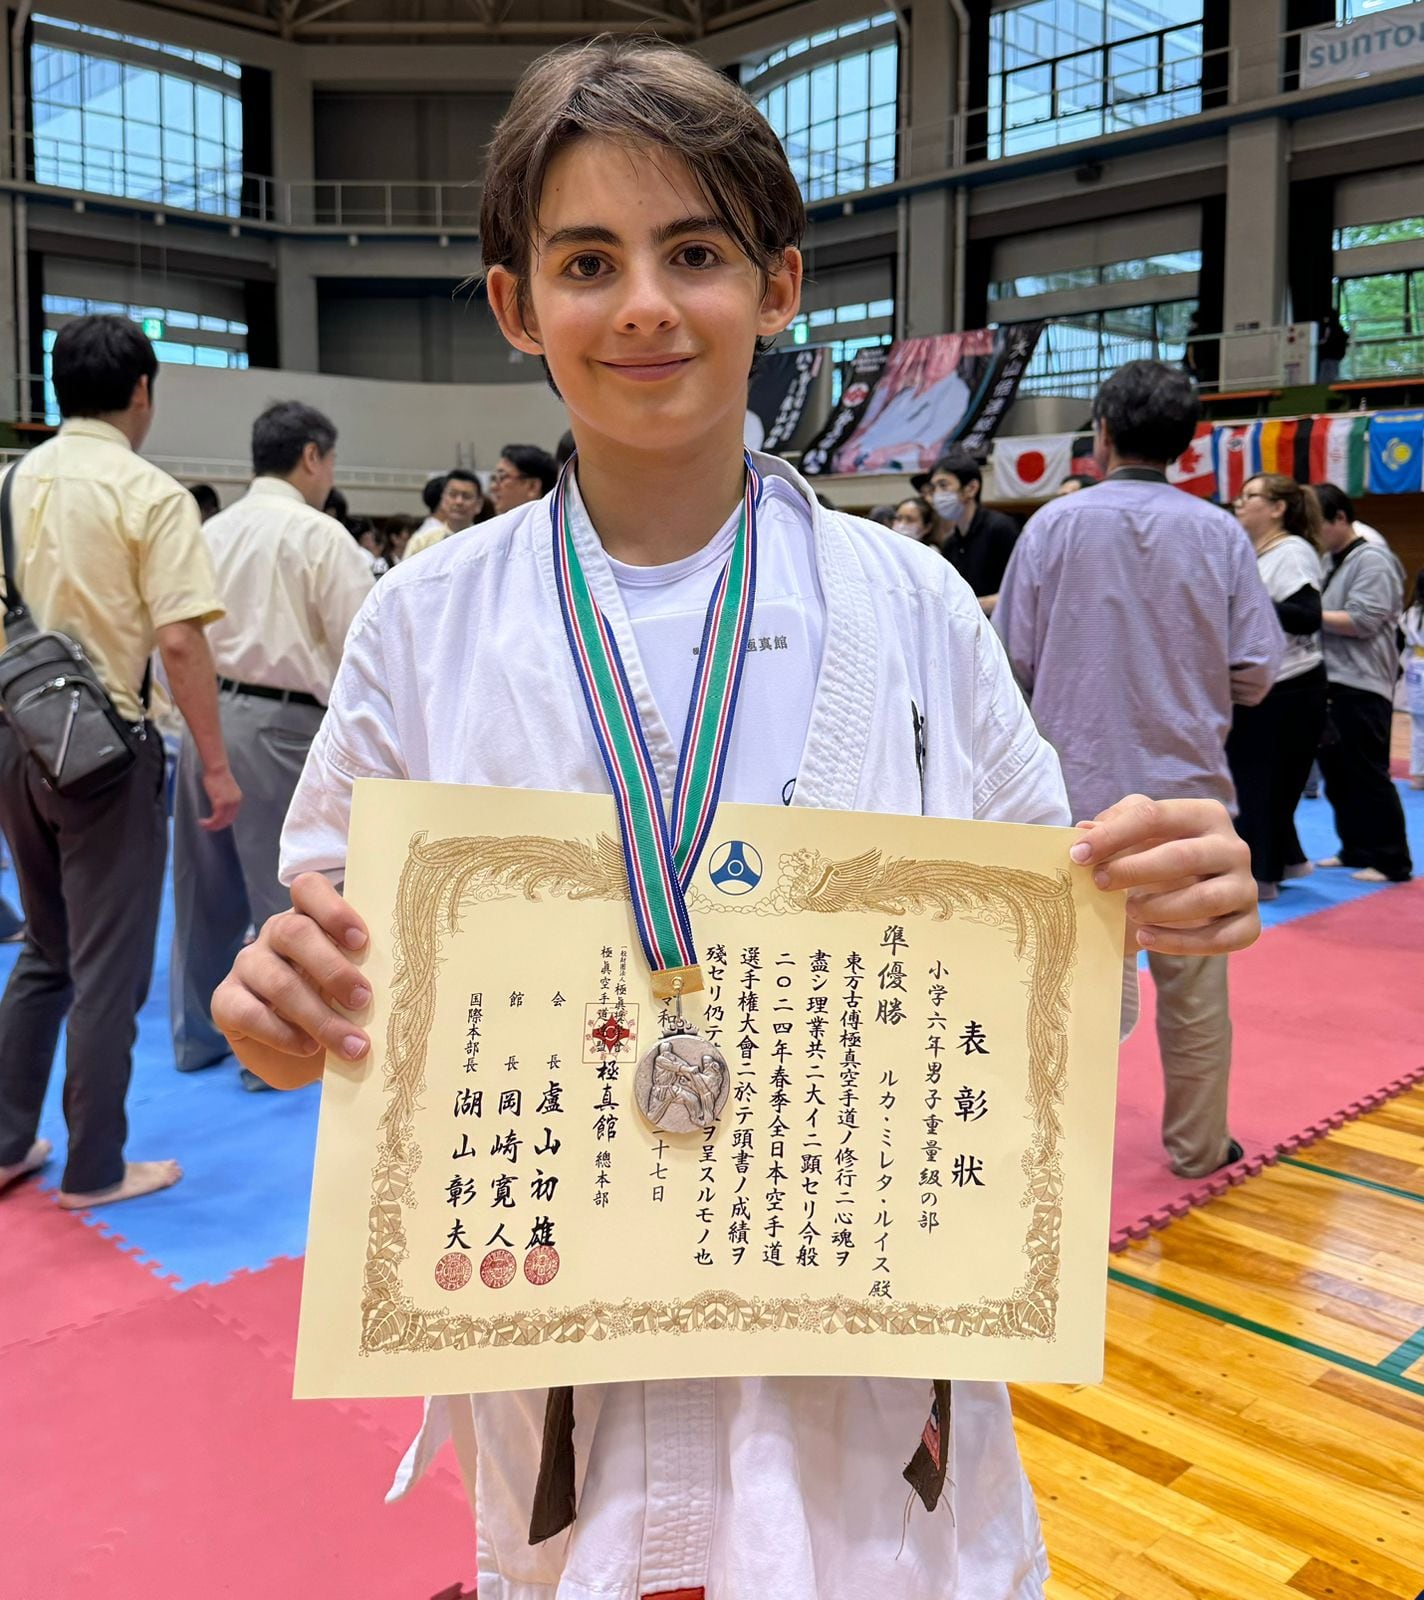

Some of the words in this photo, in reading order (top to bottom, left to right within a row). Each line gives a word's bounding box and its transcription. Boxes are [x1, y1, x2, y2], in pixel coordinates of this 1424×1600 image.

[875, 925, 909, 1025] 準優勝
[917, 960, 949, 1233] 小学六年男子重量級の部
